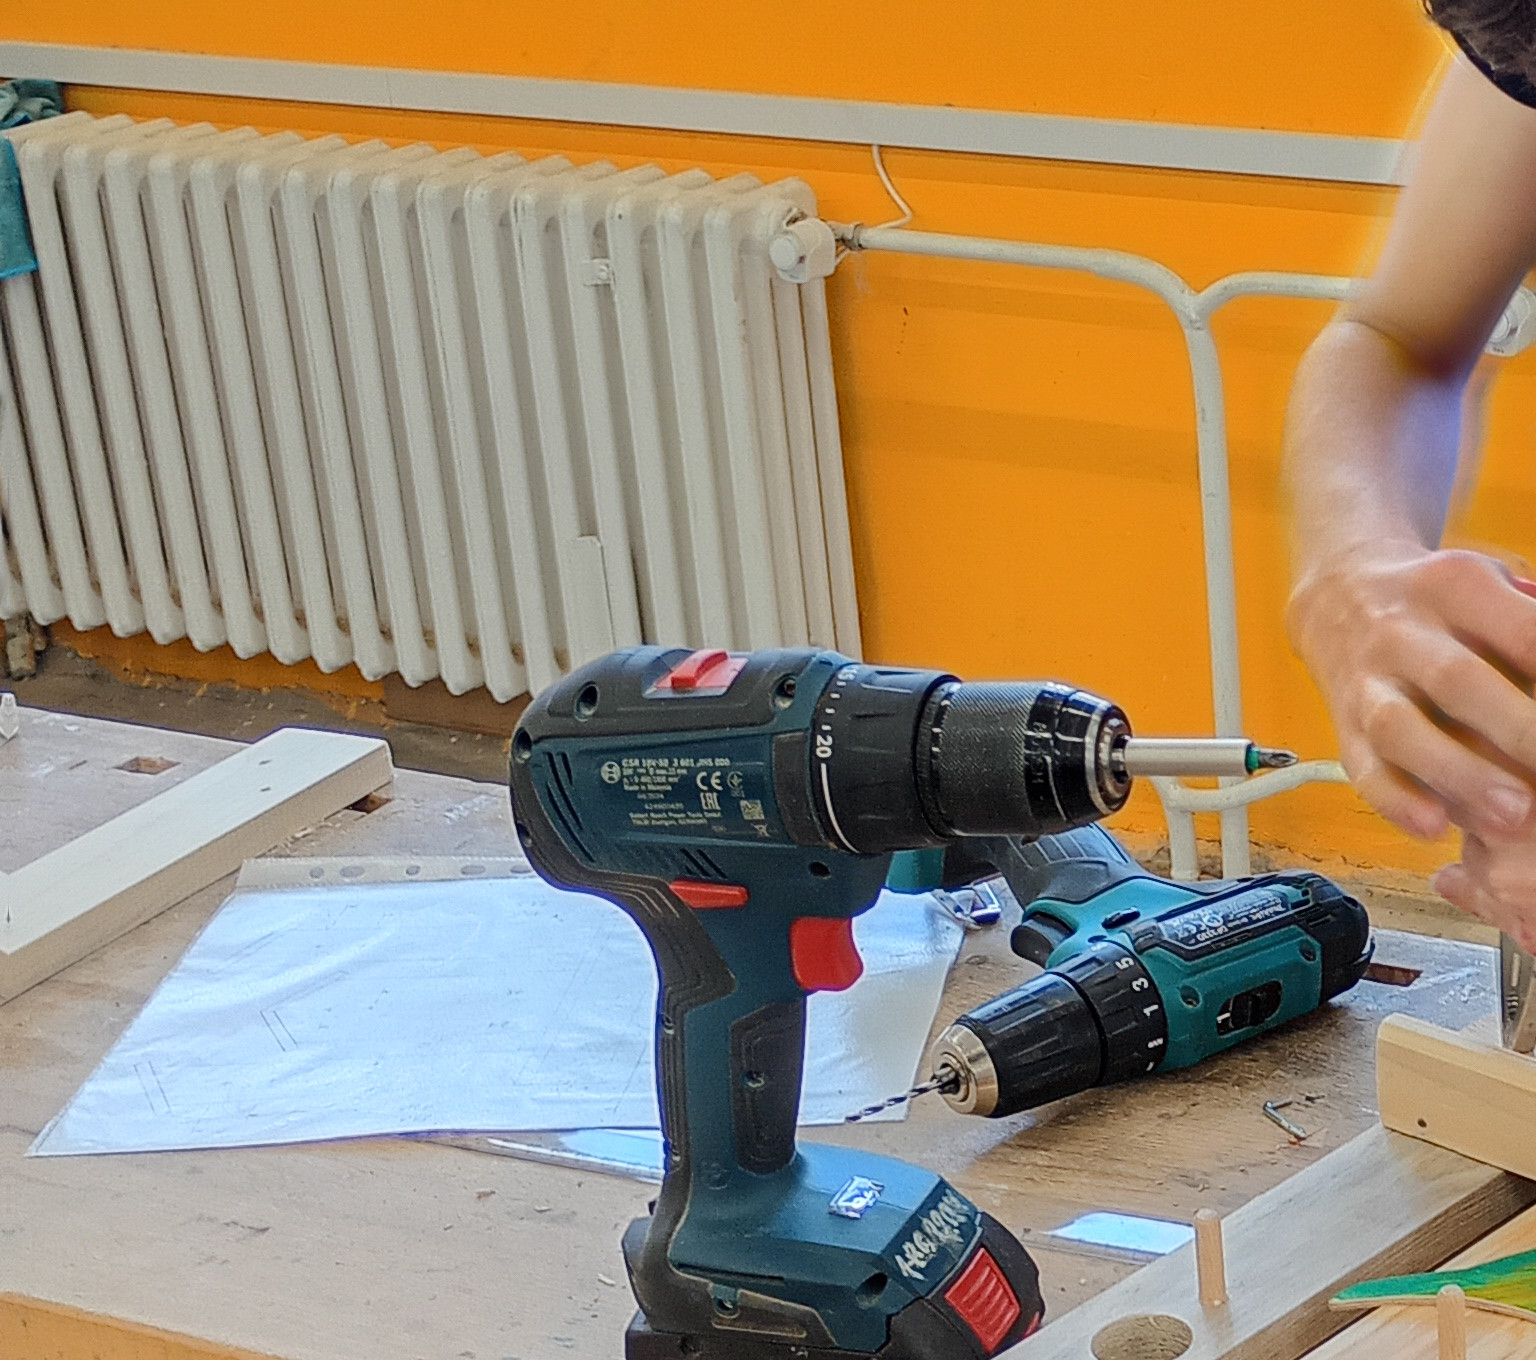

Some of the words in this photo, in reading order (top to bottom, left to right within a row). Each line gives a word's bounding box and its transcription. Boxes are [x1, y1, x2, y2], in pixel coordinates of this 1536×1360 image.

[815, 734, 833, 758] 20
[696, 771, 723, 791] CE
[1115, 957, 1134, 970] 5
[1132, 977, 1149, 992] 3
[1143, 1004, 1159, 1018] 1
